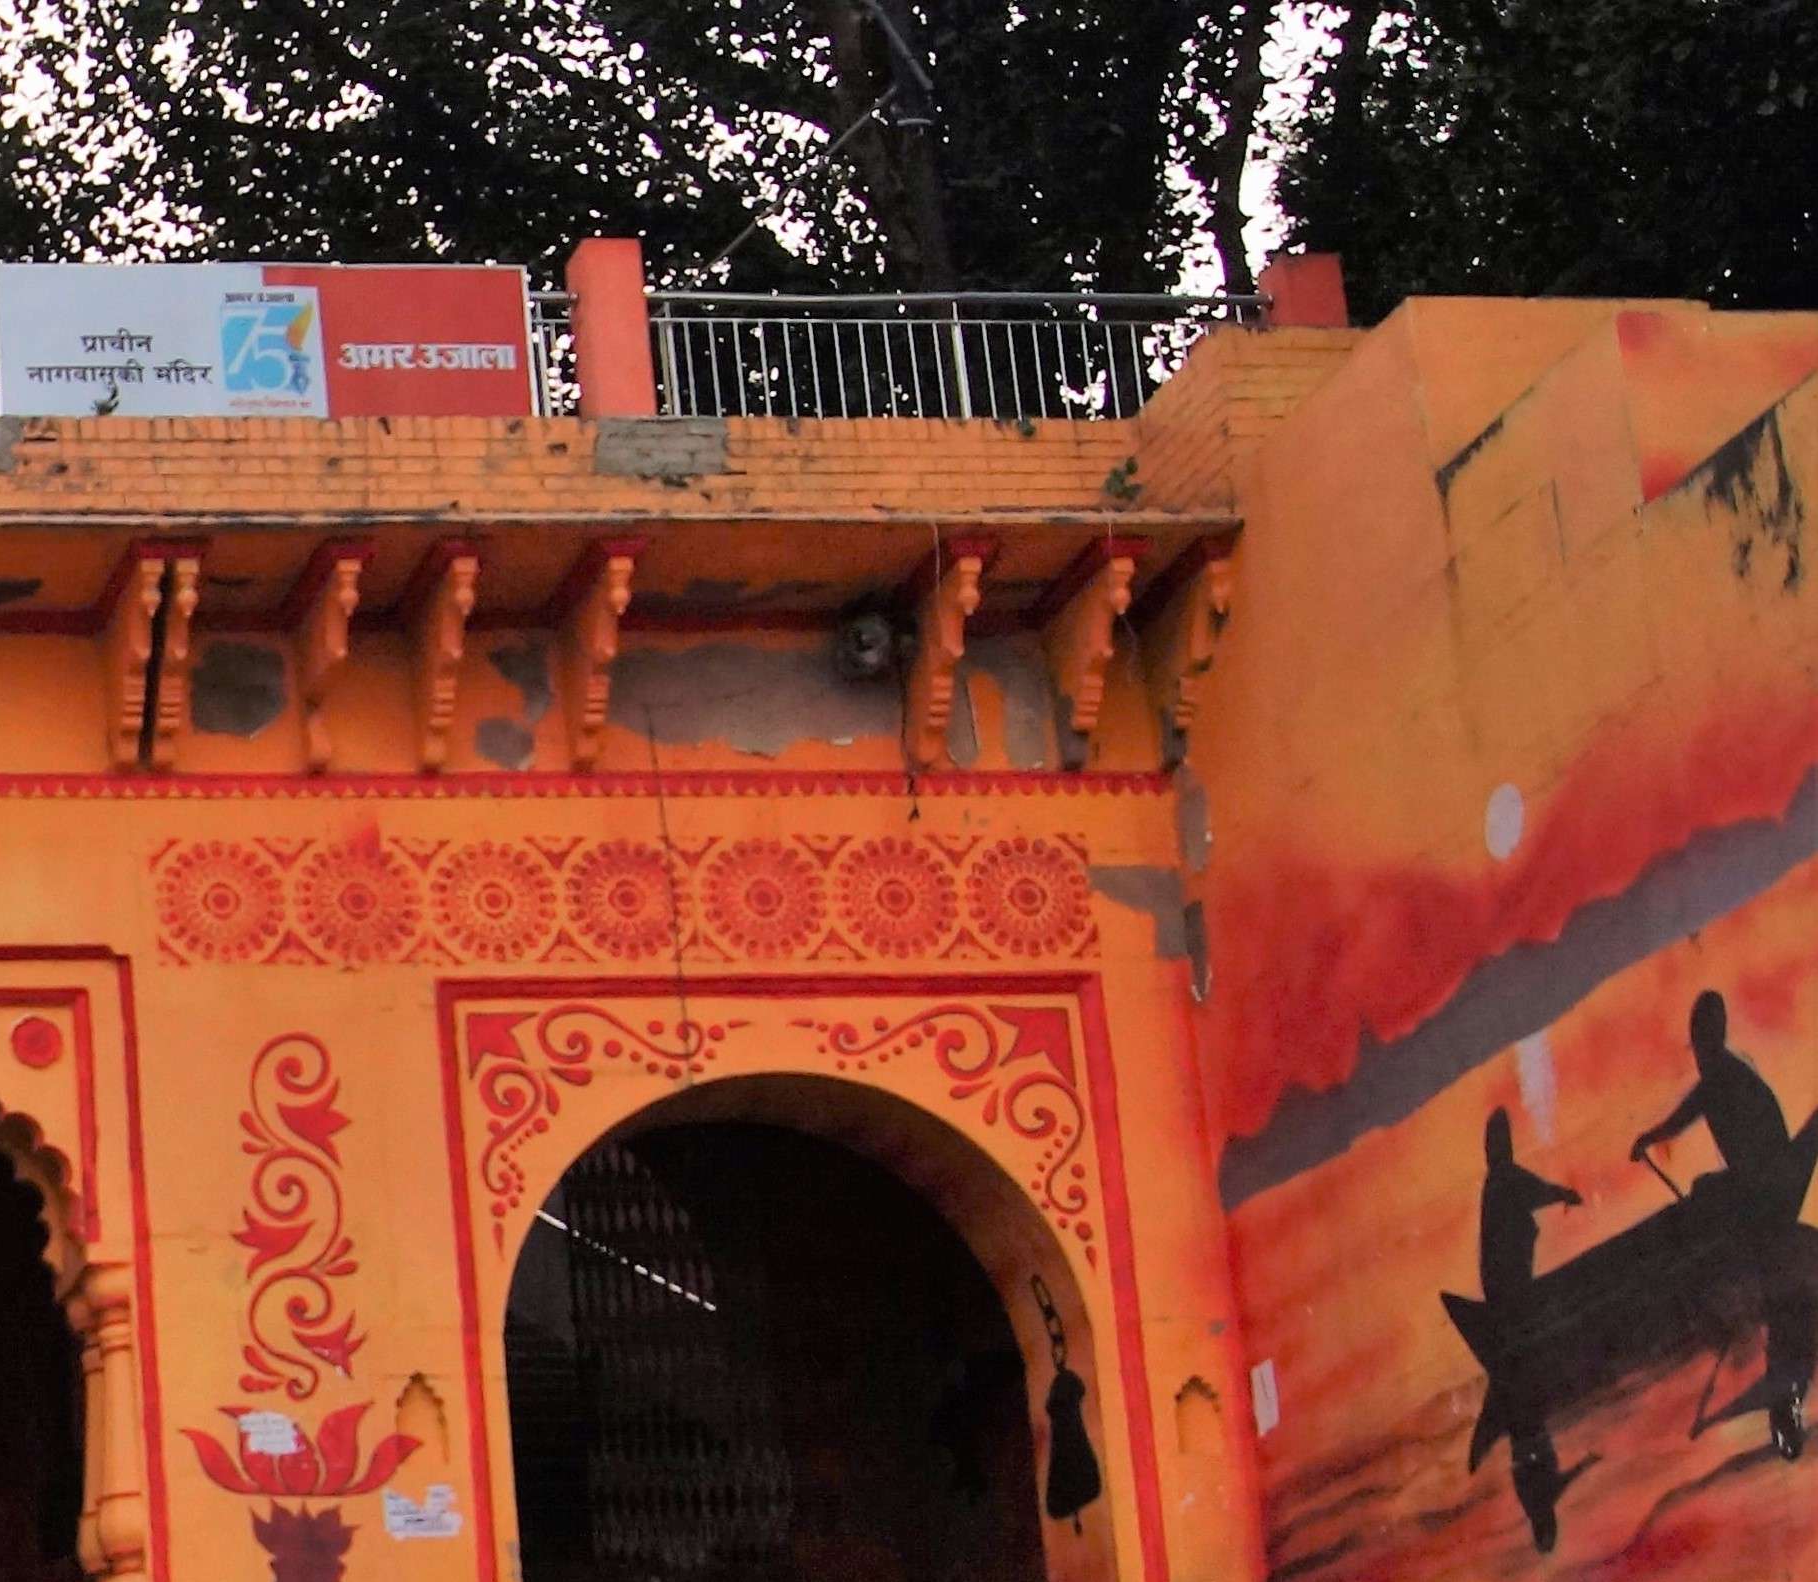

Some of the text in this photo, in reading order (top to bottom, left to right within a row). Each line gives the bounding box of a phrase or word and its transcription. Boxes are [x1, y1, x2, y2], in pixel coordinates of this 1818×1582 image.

[80, 328, 153, 353] प्राचीन
[338, 342, 517, 370] अमर उजाला
